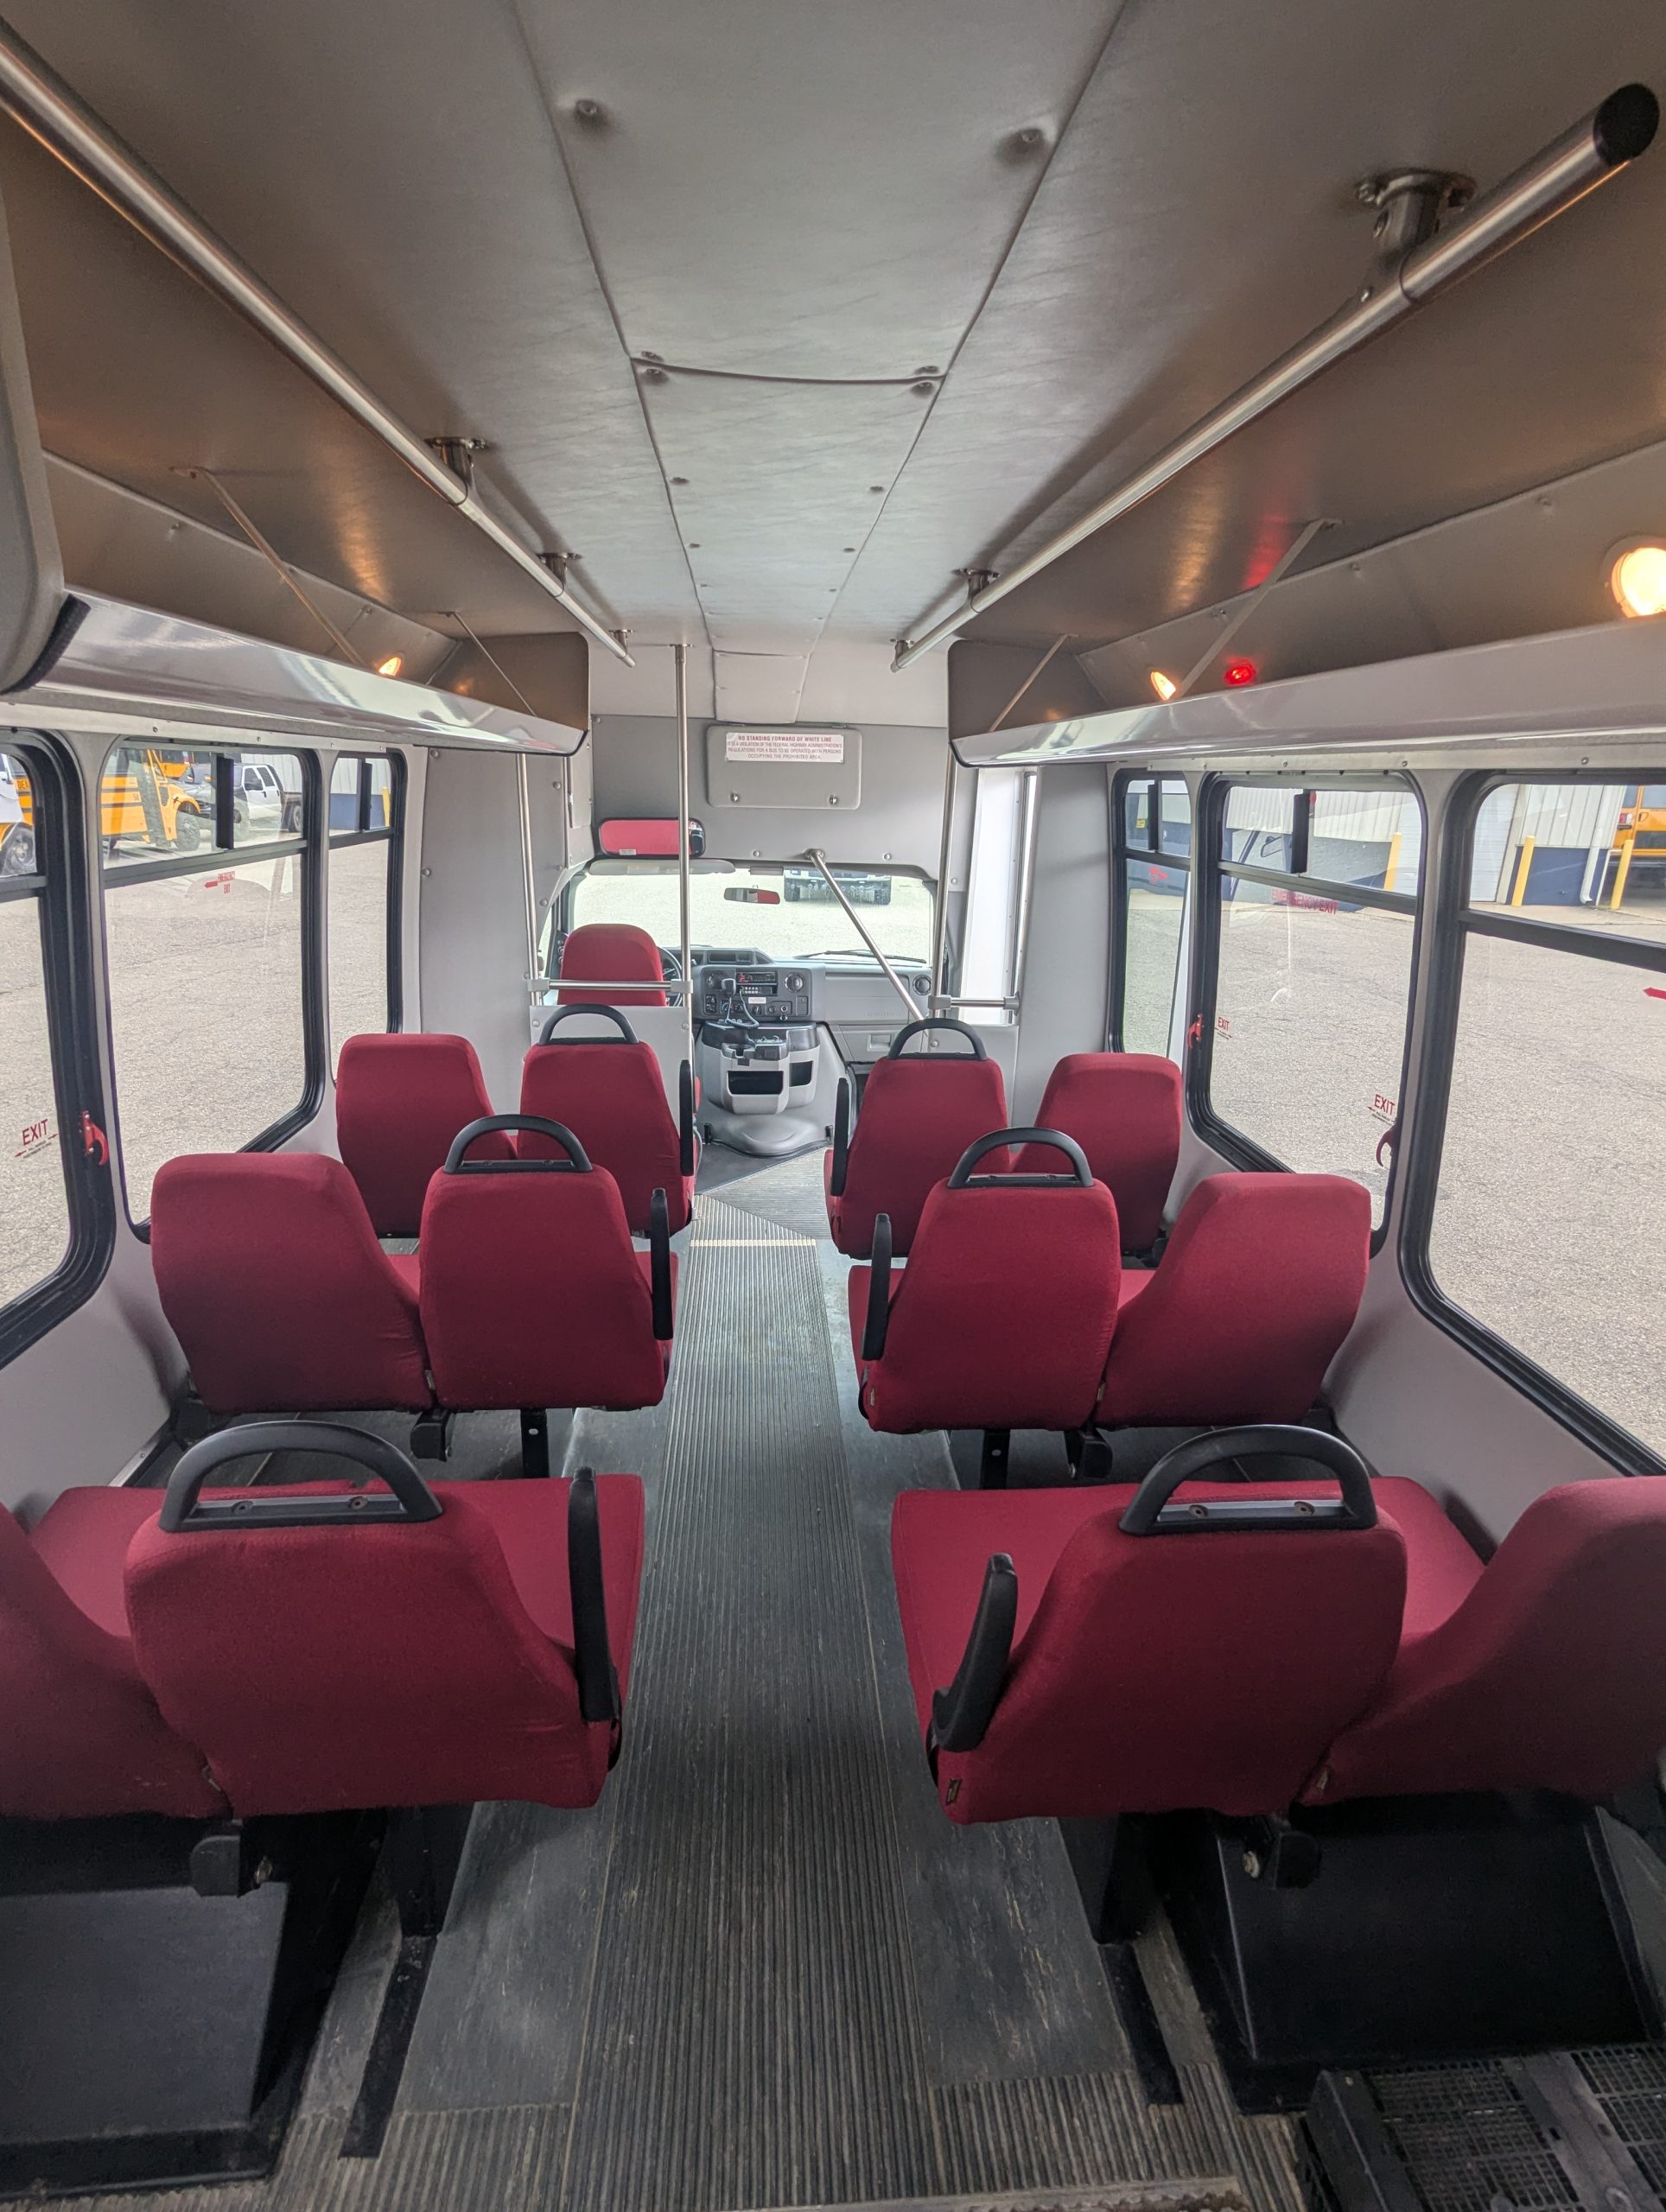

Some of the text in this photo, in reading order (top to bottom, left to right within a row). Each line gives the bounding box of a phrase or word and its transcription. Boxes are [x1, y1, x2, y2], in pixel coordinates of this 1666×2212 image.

[1272, 889, 1338, 914] EMERGENCY EXIT
[1218, 1017, 1230, 1031] EXIT
[1374, 1094, 1395, 1115] EXIT
[22, 1119, 48, 1146] EXIT
